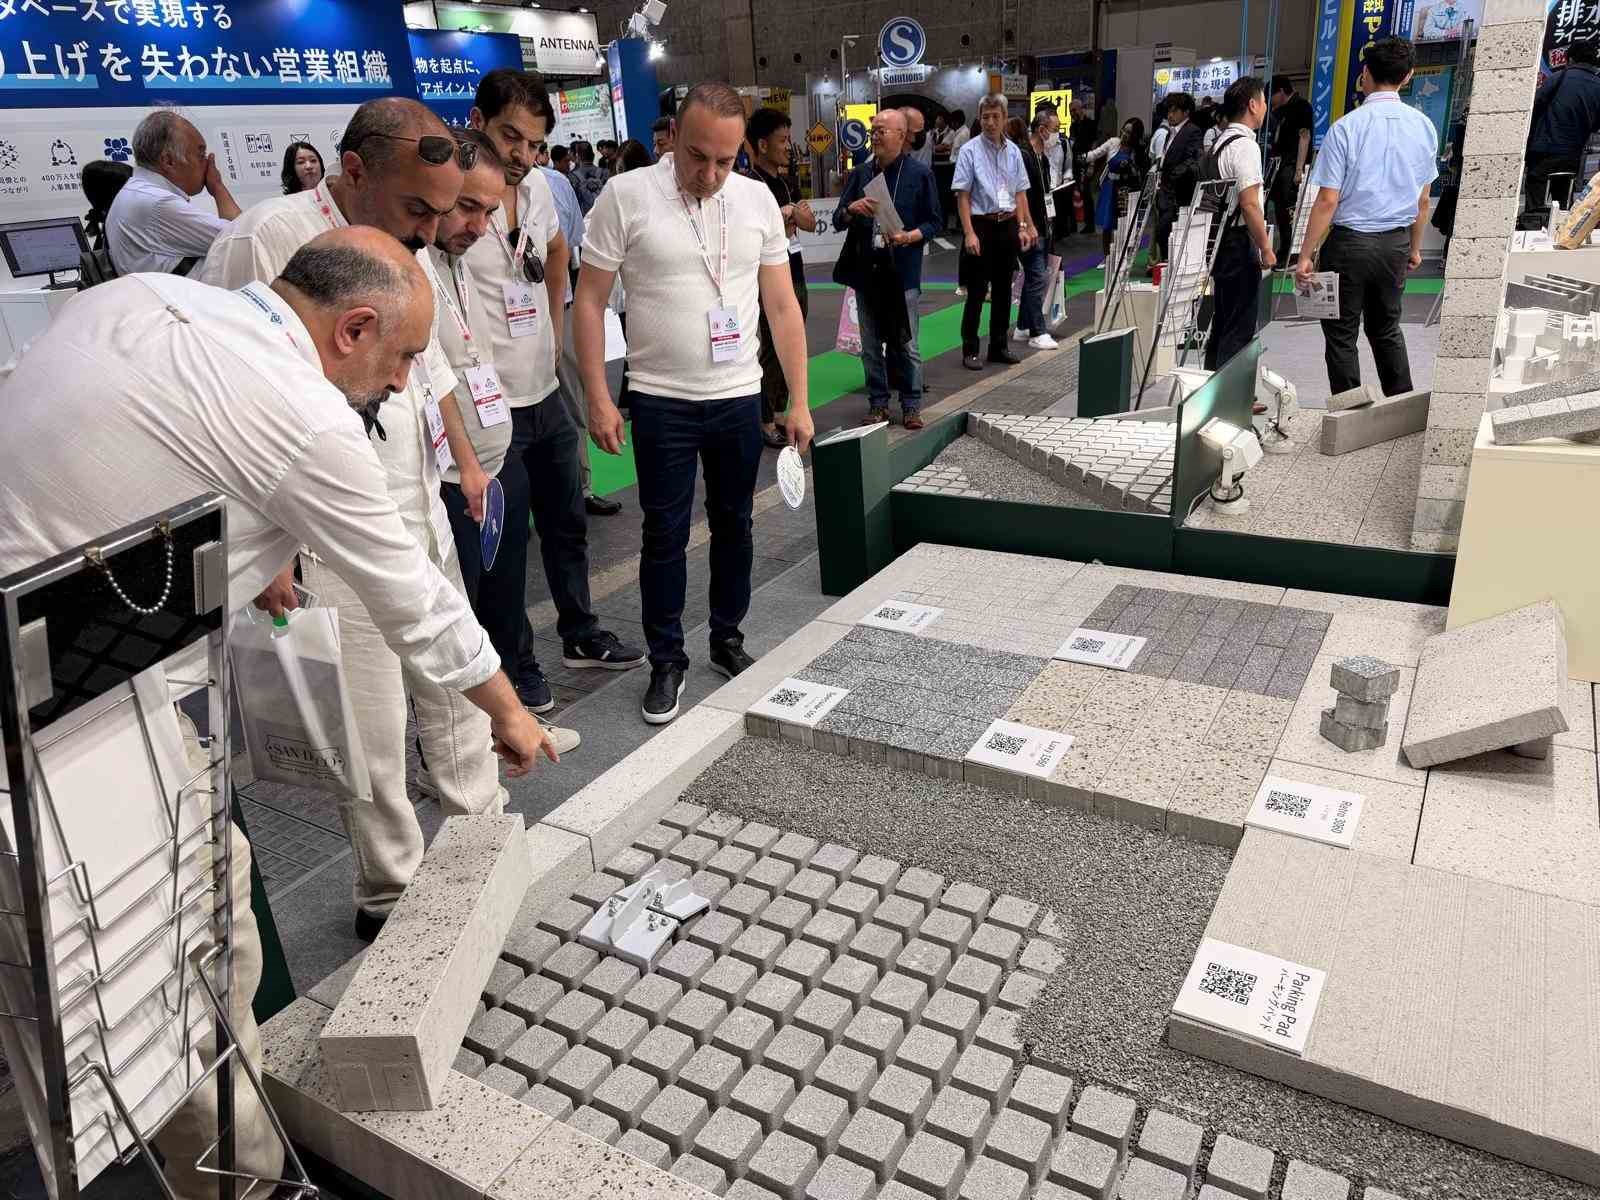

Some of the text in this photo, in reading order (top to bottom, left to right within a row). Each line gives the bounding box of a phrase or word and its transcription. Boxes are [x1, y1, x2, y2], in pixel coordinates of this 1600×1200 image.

[1553, 28, 1600, 43] ライニン
[540, 38, 595, 50] ANTENNA
[414, 56, 480, 74] 物を起点に、
[883, 73, 924, 84] Solutions
[417, 81, 479, 96] アポイント
[1275, 972, 1311, 1039] Parking Pad
